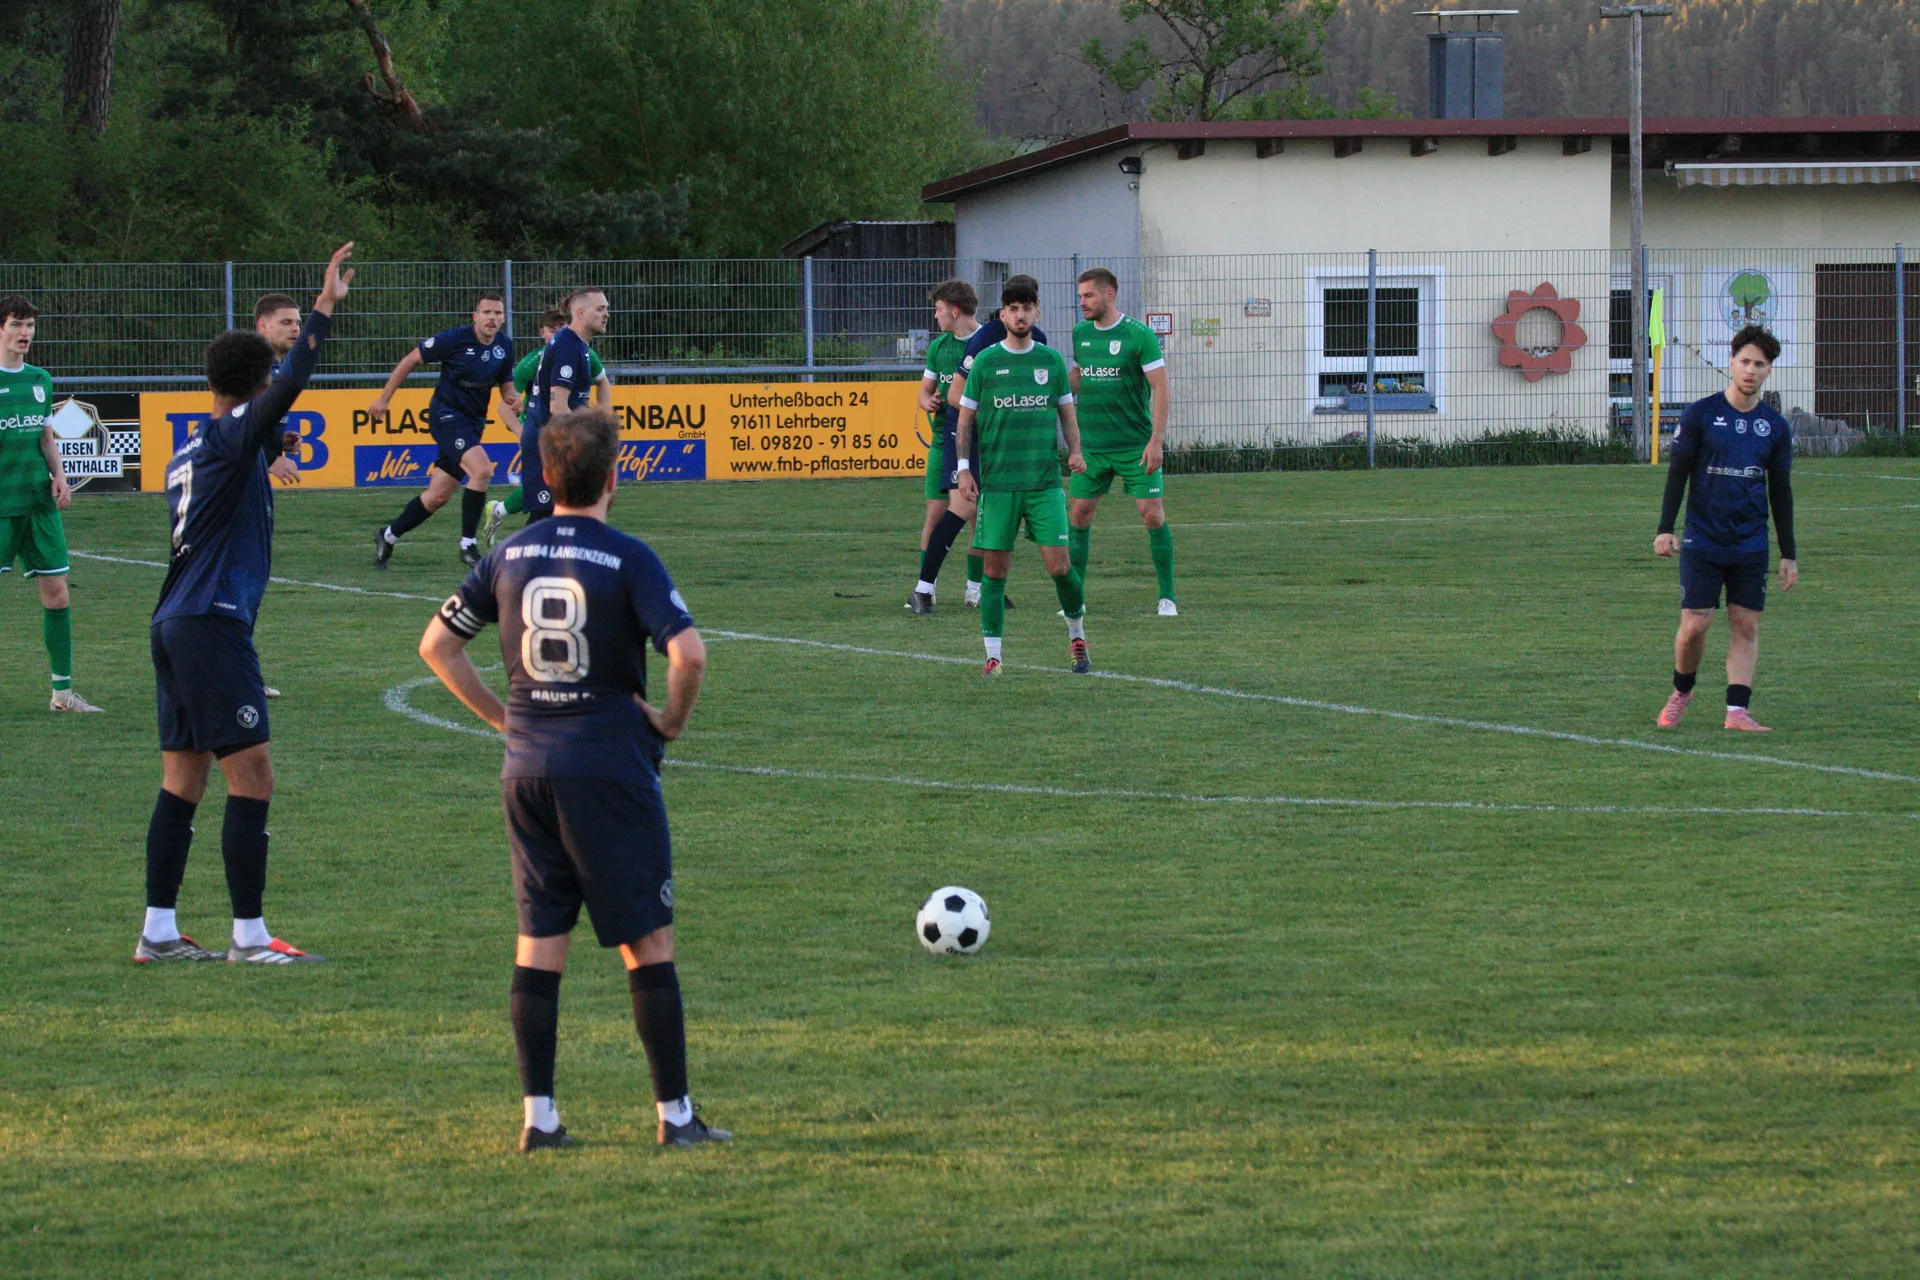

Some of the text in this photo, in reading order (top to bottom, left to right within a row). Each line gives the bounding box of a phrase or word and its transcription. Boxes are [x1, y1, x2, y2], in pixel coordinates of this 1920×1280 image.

[730, 391, 869, 408] Unterheßbach 24
[993, 394, 1050, 409] beLaser
[612, 404, 706, 430] ENBAU
[730, 413, 847, 432] 91611 Lehrberg
[678, 431, 706, 439] GmbH
[730, 436, 755, 451] Tel.
[760, 435, 813, 450] 09820
[830, 435, 847, 449] 91
[852, 434, 872, 448] 85
[878, 433, 898, 448] 60
[62, 460, 118, 473] ENTHALER
[730, 454, 926, 474] www.fnb-pflasterbau.de
[168, 460, 193, 548] 7
[505, 545, 522, 561] TSV
[549, 545, 622, 571] LANGENZENN
[441, 594, 462, 618] C
[521, 576, 589, 682] 8
